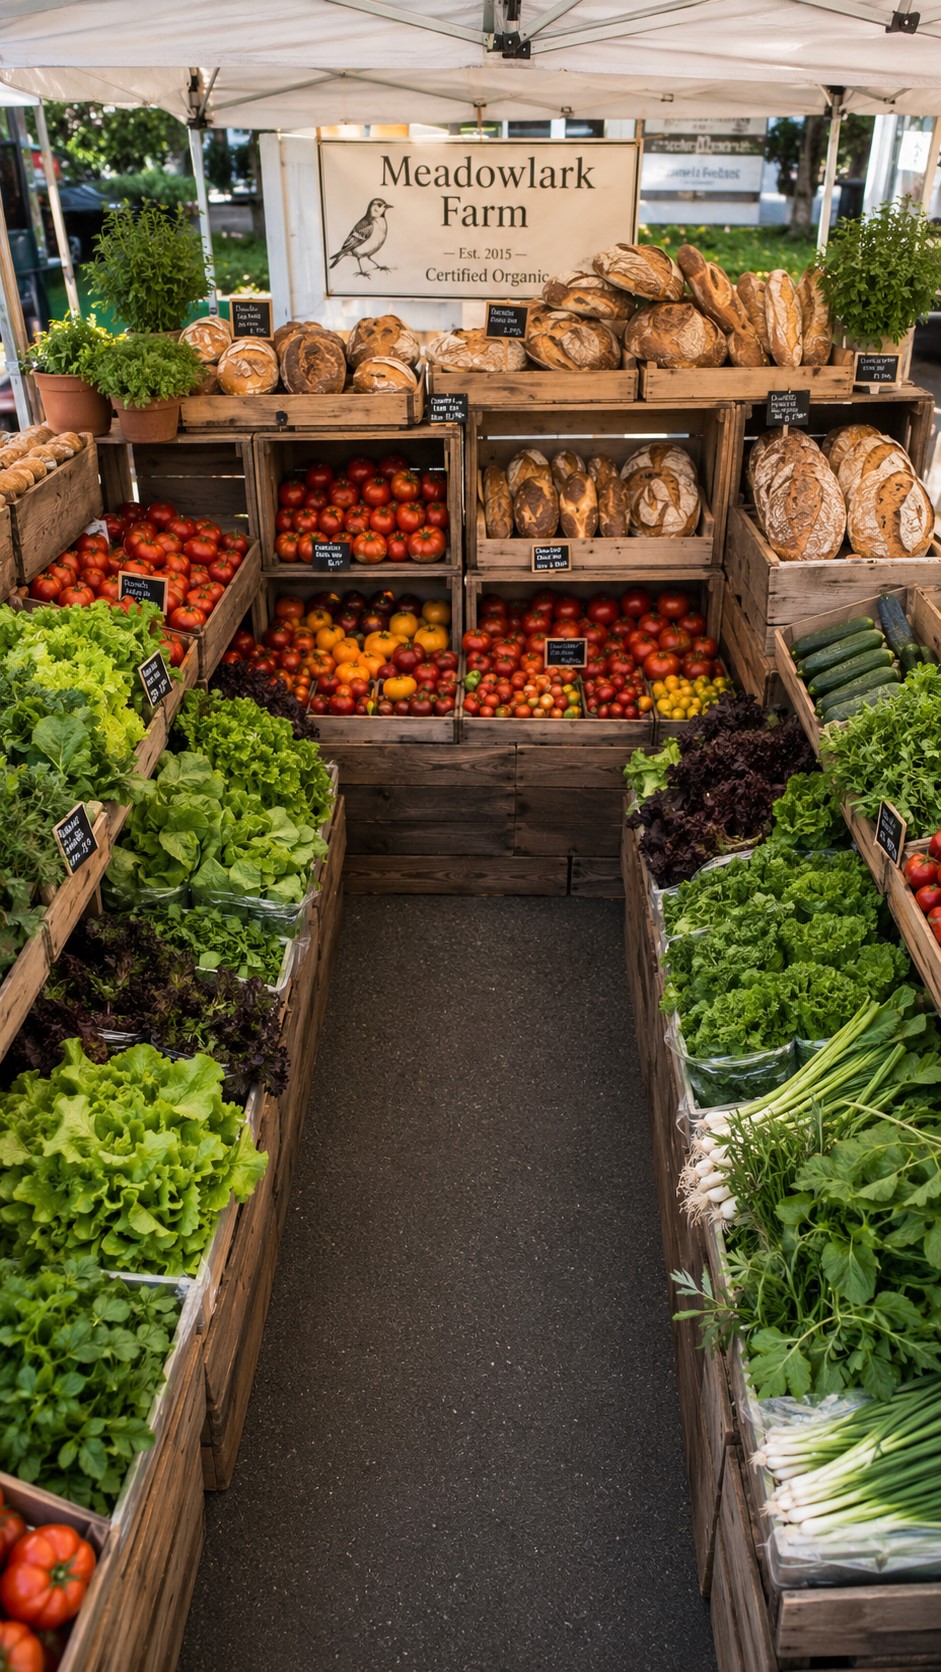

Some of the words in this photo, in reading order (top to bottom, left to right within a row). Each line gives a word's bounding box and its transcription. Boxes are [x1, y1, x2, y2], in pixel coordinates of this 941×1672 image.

[381, 155, 596, 189] Meadowlark
[440, 195, 529, 228] Farm
[459, 247, 481, 260] Est.
[484, 248, 512, 260] 2015
[425, 267, 488, 283] Certified
[492, 268, 550, 287] Organic
